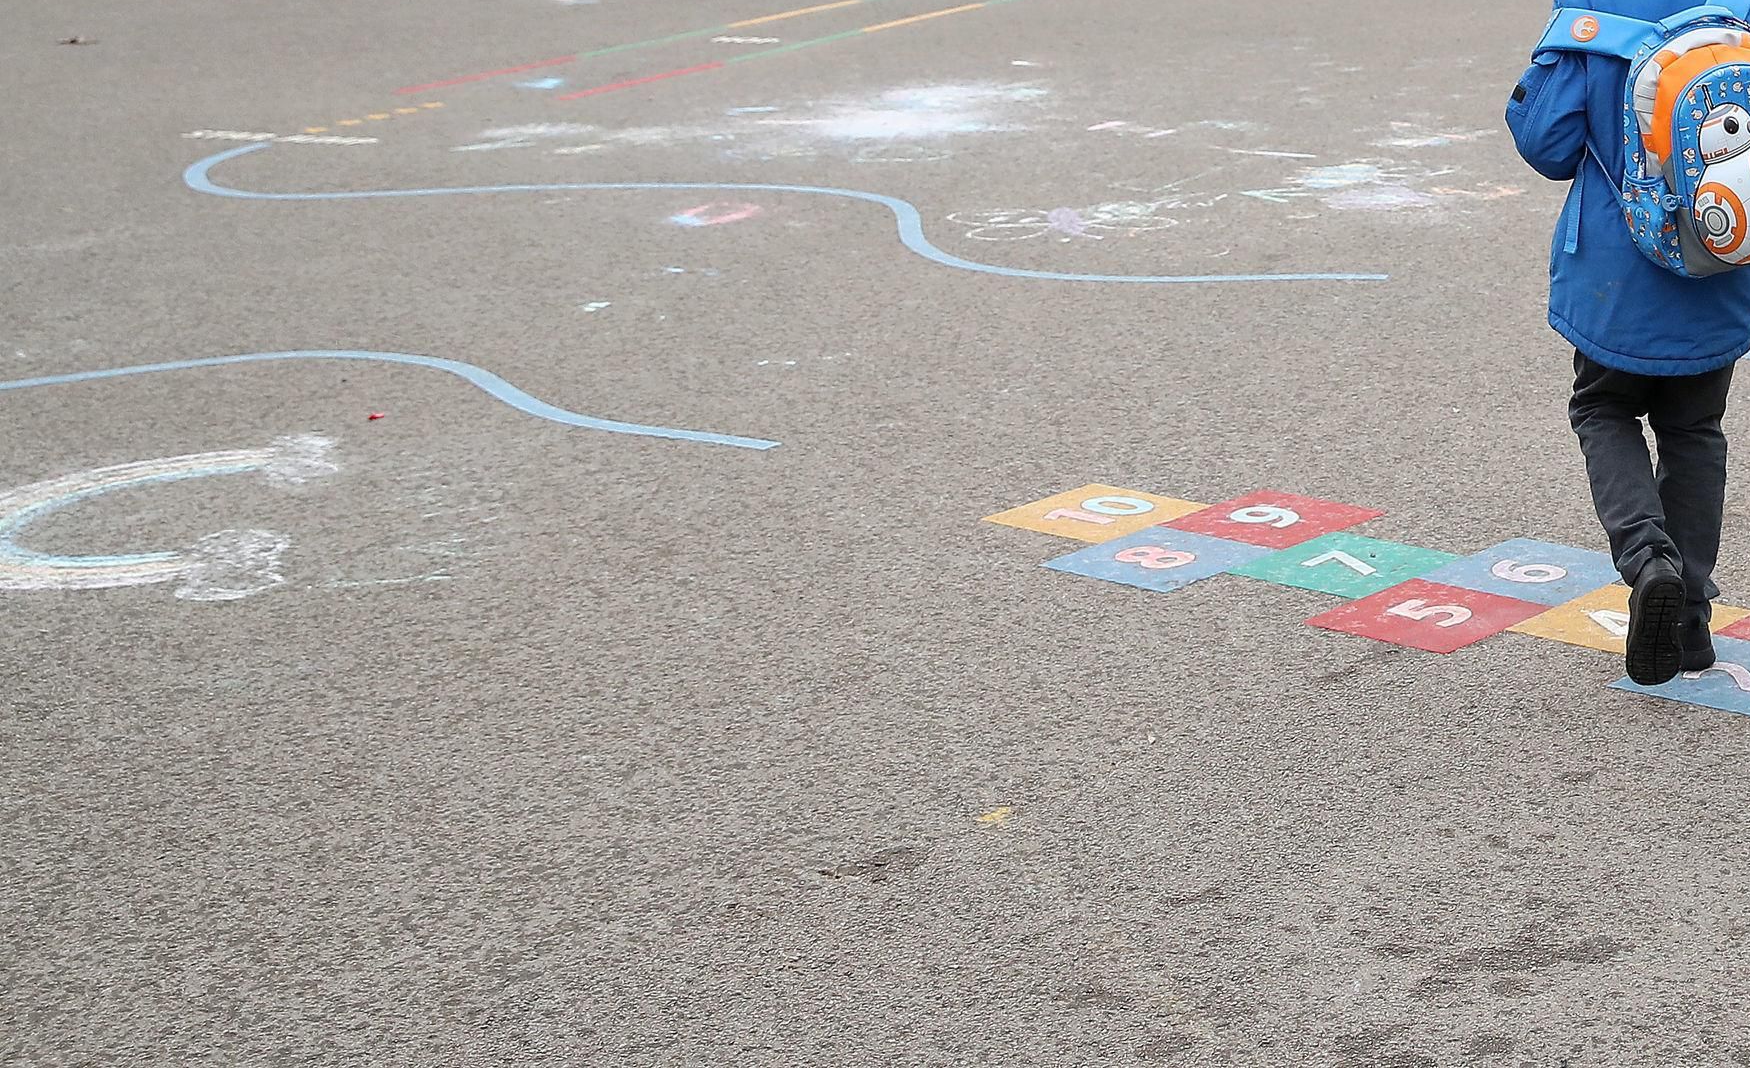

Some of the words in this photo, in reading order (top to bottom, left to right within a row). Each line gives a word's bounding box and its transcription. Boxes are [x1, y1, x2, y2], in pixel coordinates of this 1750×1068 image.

[1041, 494, 1156, 526] 10
[1228, 503, 1302, 529] 9
[1113, 544, 1198, 570] 8
[1300, 548, 1378, 577] 7
[1490, 558, 1569, 584] 6
[1385, 597, 1474, 630] 5
